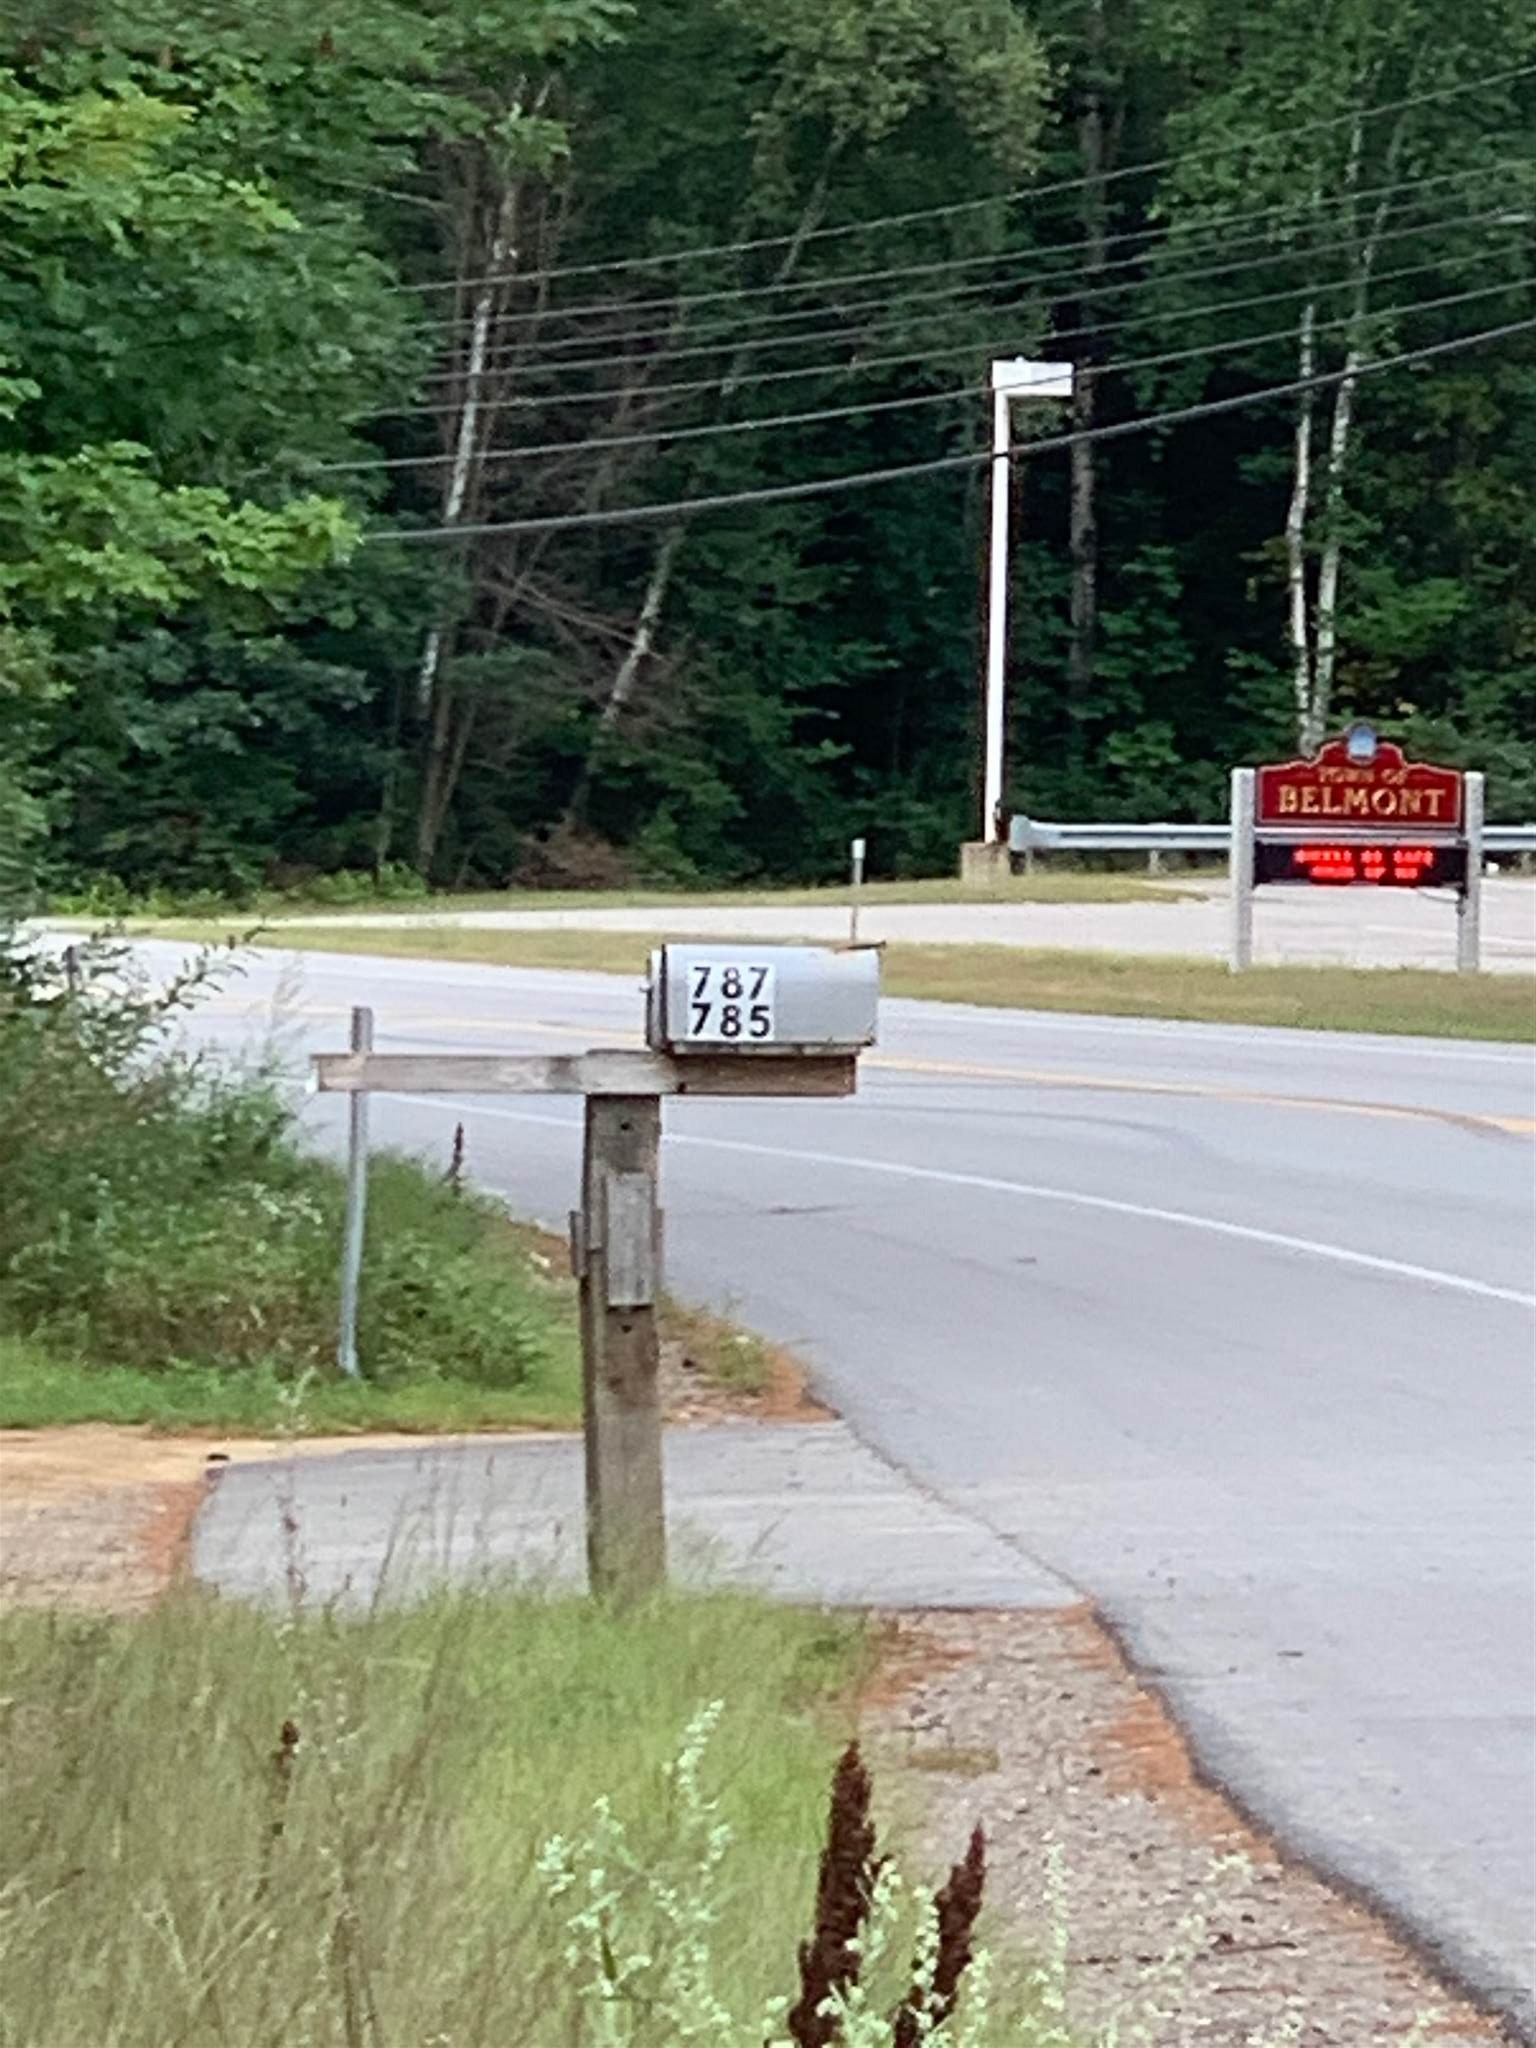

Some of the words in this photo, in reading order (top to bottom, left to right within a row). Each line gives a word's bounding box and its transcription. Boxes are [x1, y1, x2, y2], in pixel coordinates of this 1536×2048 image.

[1318, 766, 1374, 784] TOWN
[1382, 768, 1408, 785] OF
[1278, 785, 1446, 816] BELMONT
[693, 966, 768, 1000] 787
[691, 1002, 770, 1037] 785
